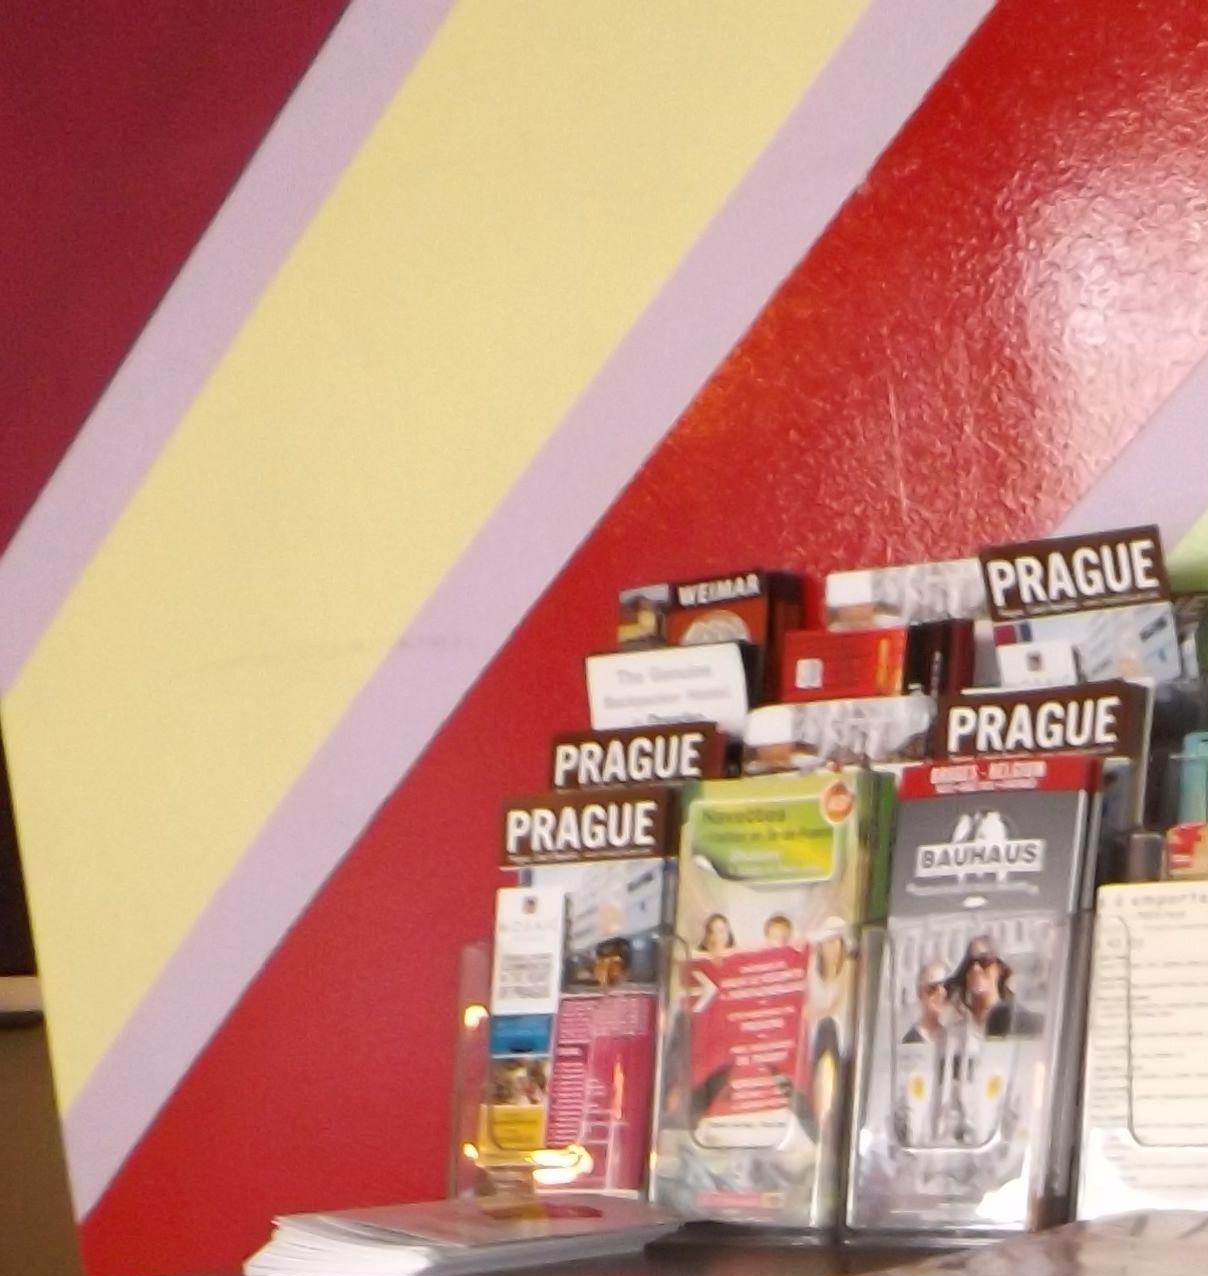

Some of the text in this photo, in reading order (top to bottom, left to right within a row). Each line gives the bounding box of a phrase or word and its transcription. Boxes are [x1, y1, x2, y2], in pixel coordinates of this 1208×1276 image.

[986, 539, 1160, 607] PRAGUE
[947, 696, 1122, 753] PRAGUE
[553, 732, 706, 788] PRAGUE
[505, 800, 658, 854] PRAGUE
[920, 842, 1038, 869] BAUHAUS
